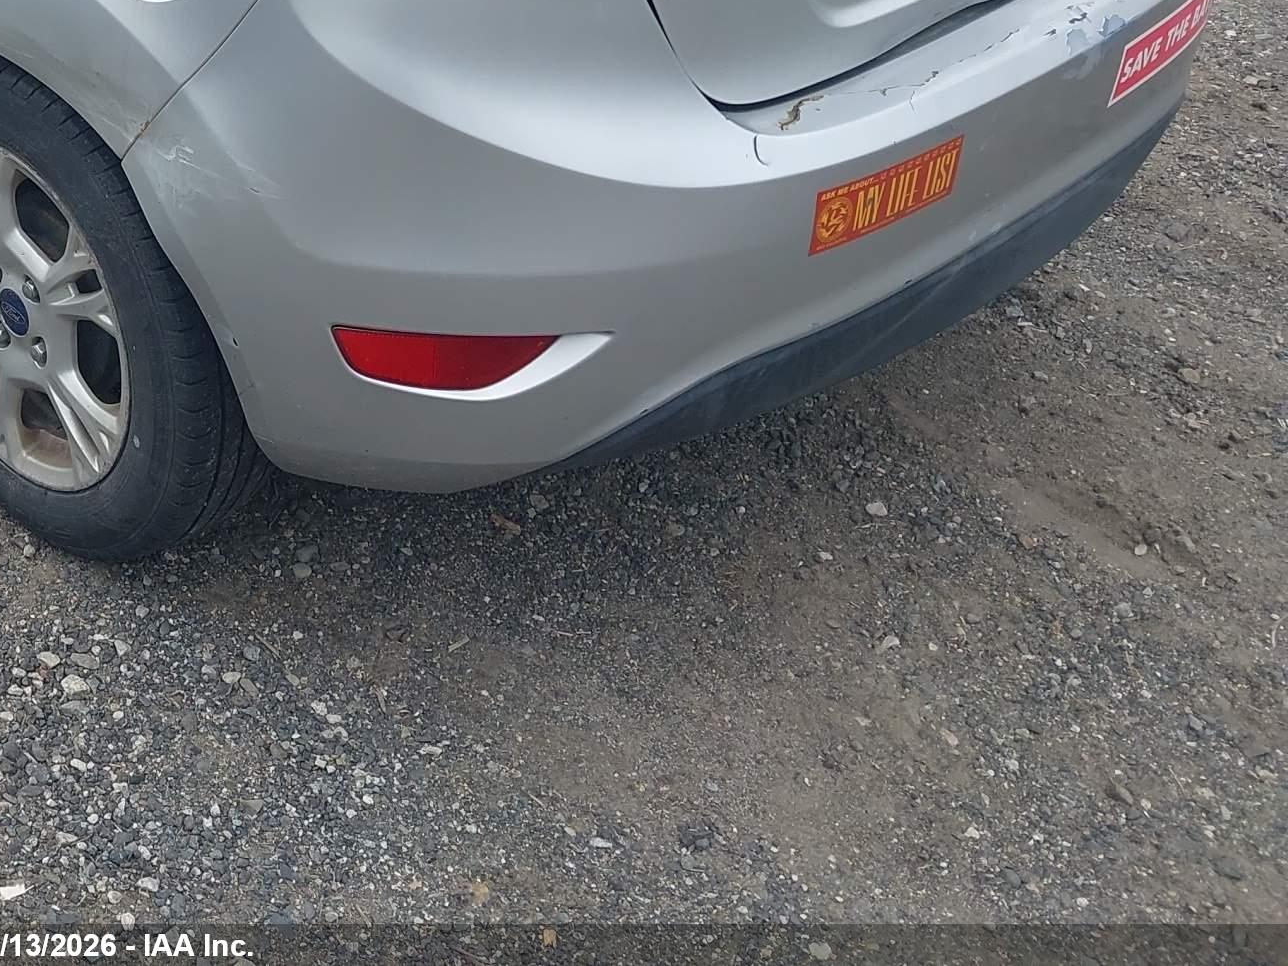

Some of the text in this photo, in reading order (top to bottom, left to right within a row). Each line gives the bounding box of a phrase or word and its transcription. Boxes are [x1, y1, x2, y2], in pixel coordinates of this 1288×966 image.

[1120, 36, 1163, 84] SAVE
[1165, 13, 1192, 51] THE
[852, 182, 886, 231] MY
[886, 166, 923, 218] LIFE
[922, 148, 960, 201] LIST
